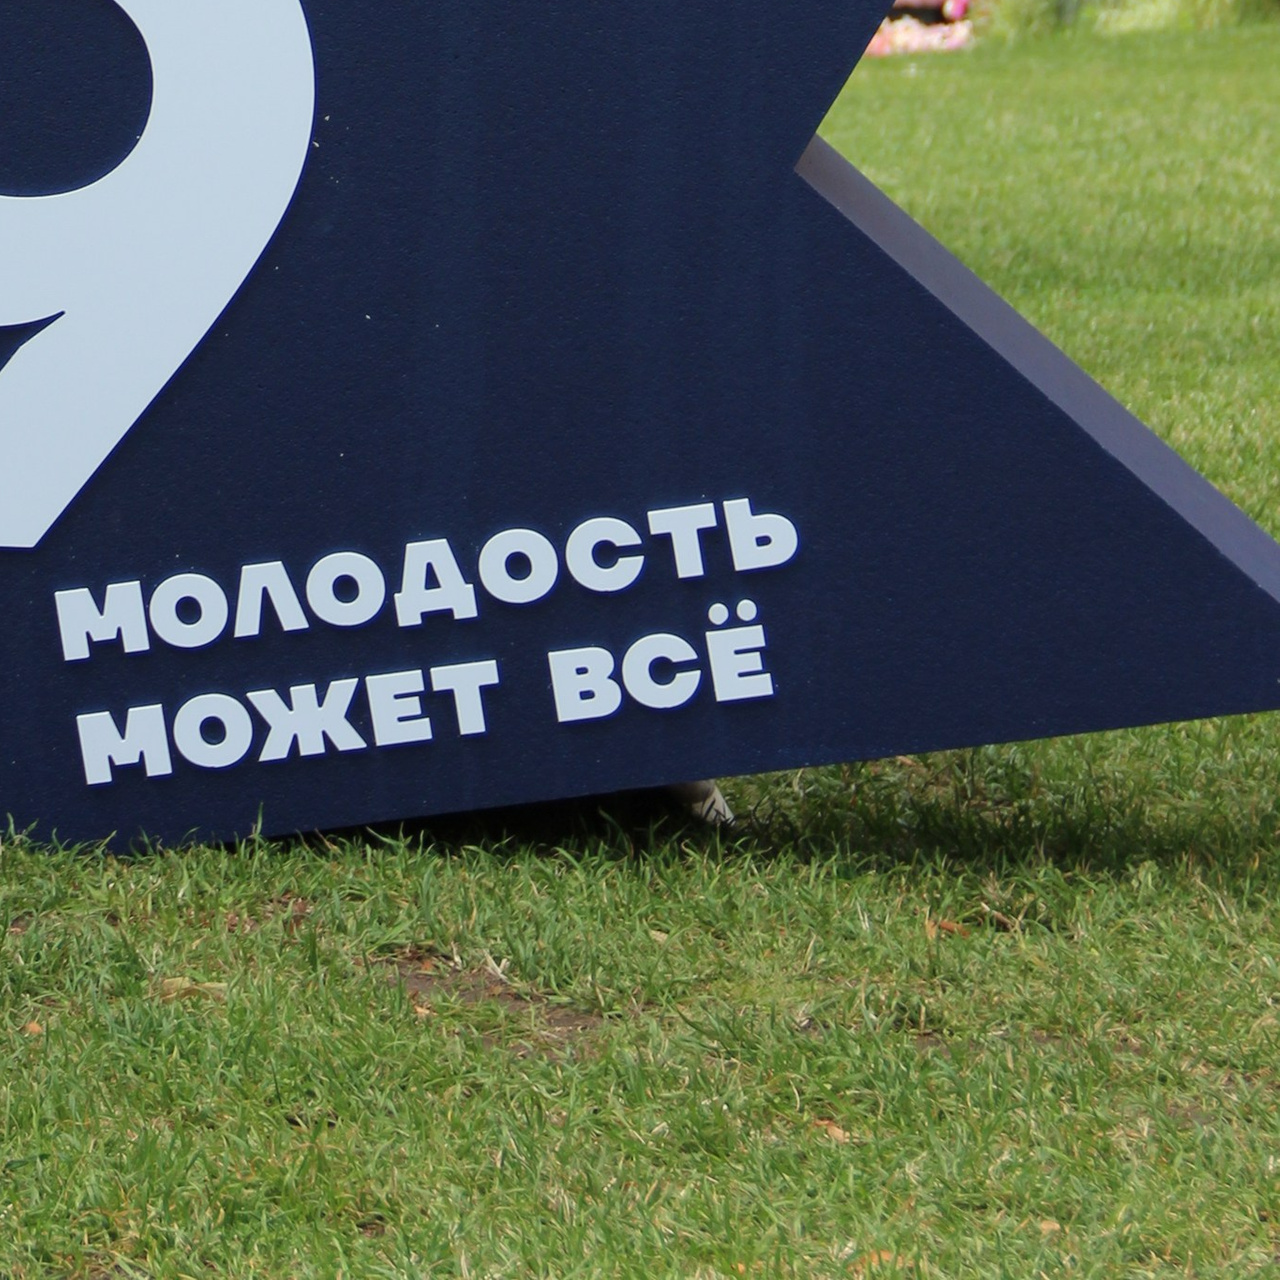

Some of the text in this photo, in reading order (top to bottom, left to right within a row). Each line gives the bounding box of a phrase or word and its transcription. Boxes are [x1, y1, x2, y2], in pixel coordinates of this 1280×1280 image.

[54, 498, 798, 661] МОЛОДОСТЬ
[76, 599, 774, 785] МОЖЕТ ВСЁ
